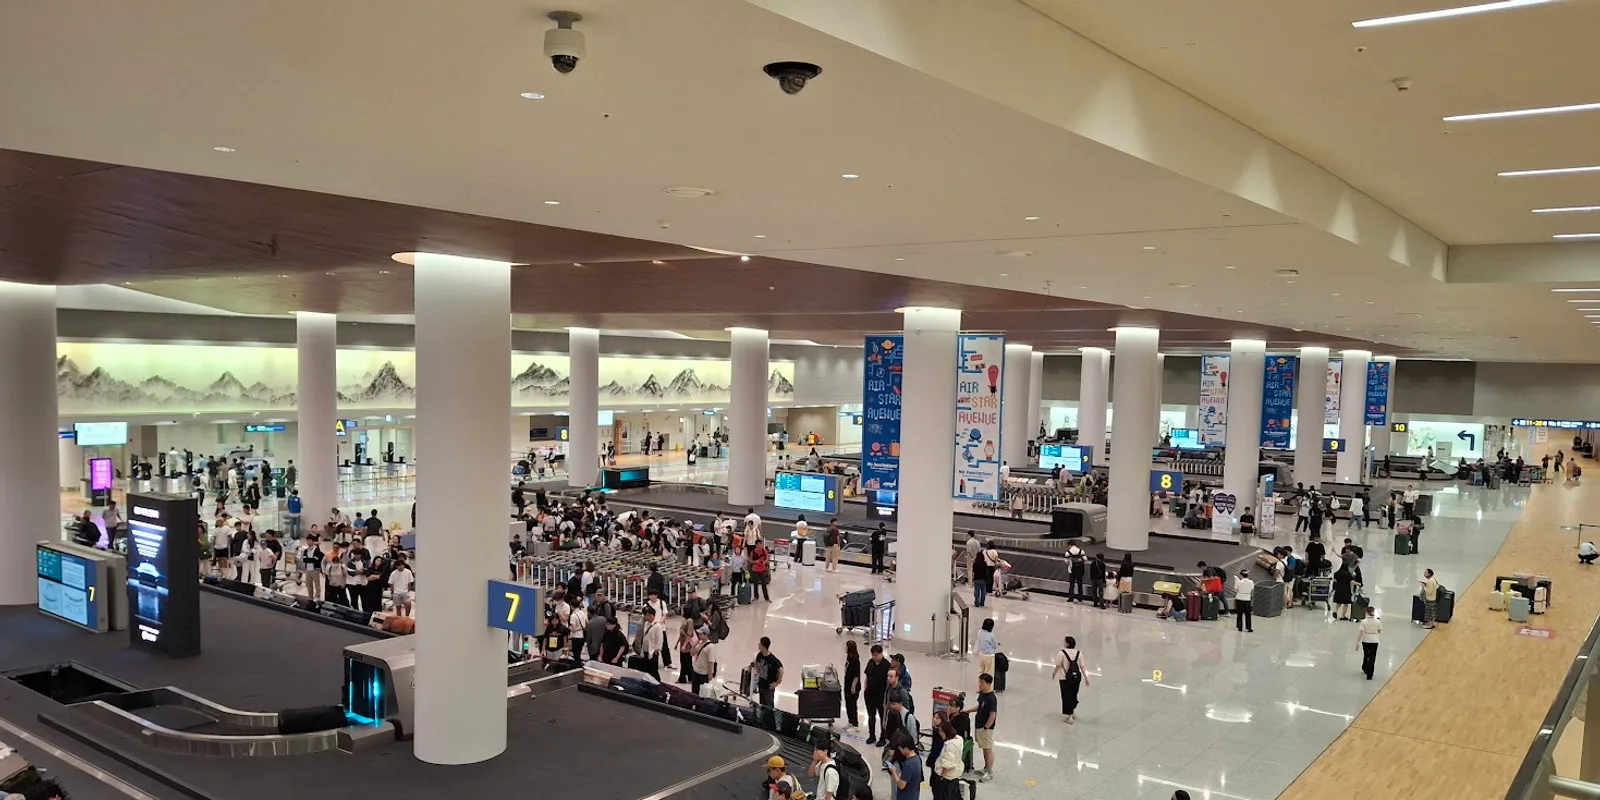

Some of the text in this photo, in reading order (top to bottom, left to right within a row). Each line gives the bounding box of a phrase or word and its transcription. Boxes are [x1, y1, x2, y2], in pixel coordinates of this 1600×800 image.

[868, 379, 885, 391] AIR
[959, 381, 979, 394] AIR
[1266, 381, 1279, 389] AIR
[878, 394, 901, 405] STAR
[1274, 390, 1291, 398] STAR
[971, 396, 998, 409] STAR
[867, 407, 901, 421] AVENUE
[958, 411, 997, 425] AVENUE
[857, 416, 863, 424] 9
[336, 420, 345, 432] A
[1395, 424, 1405, 432] 10
[561, 429, 568, 440] 8
[1330, 440, 1338, 450] 9
[1083, 455, 1089, 463] 9
[1160, 473, 1173, 489] 8
[827, 490, 834, 499] 8
[88, 586, 95, 602] 7
[504, 592, 520, 623] 7
